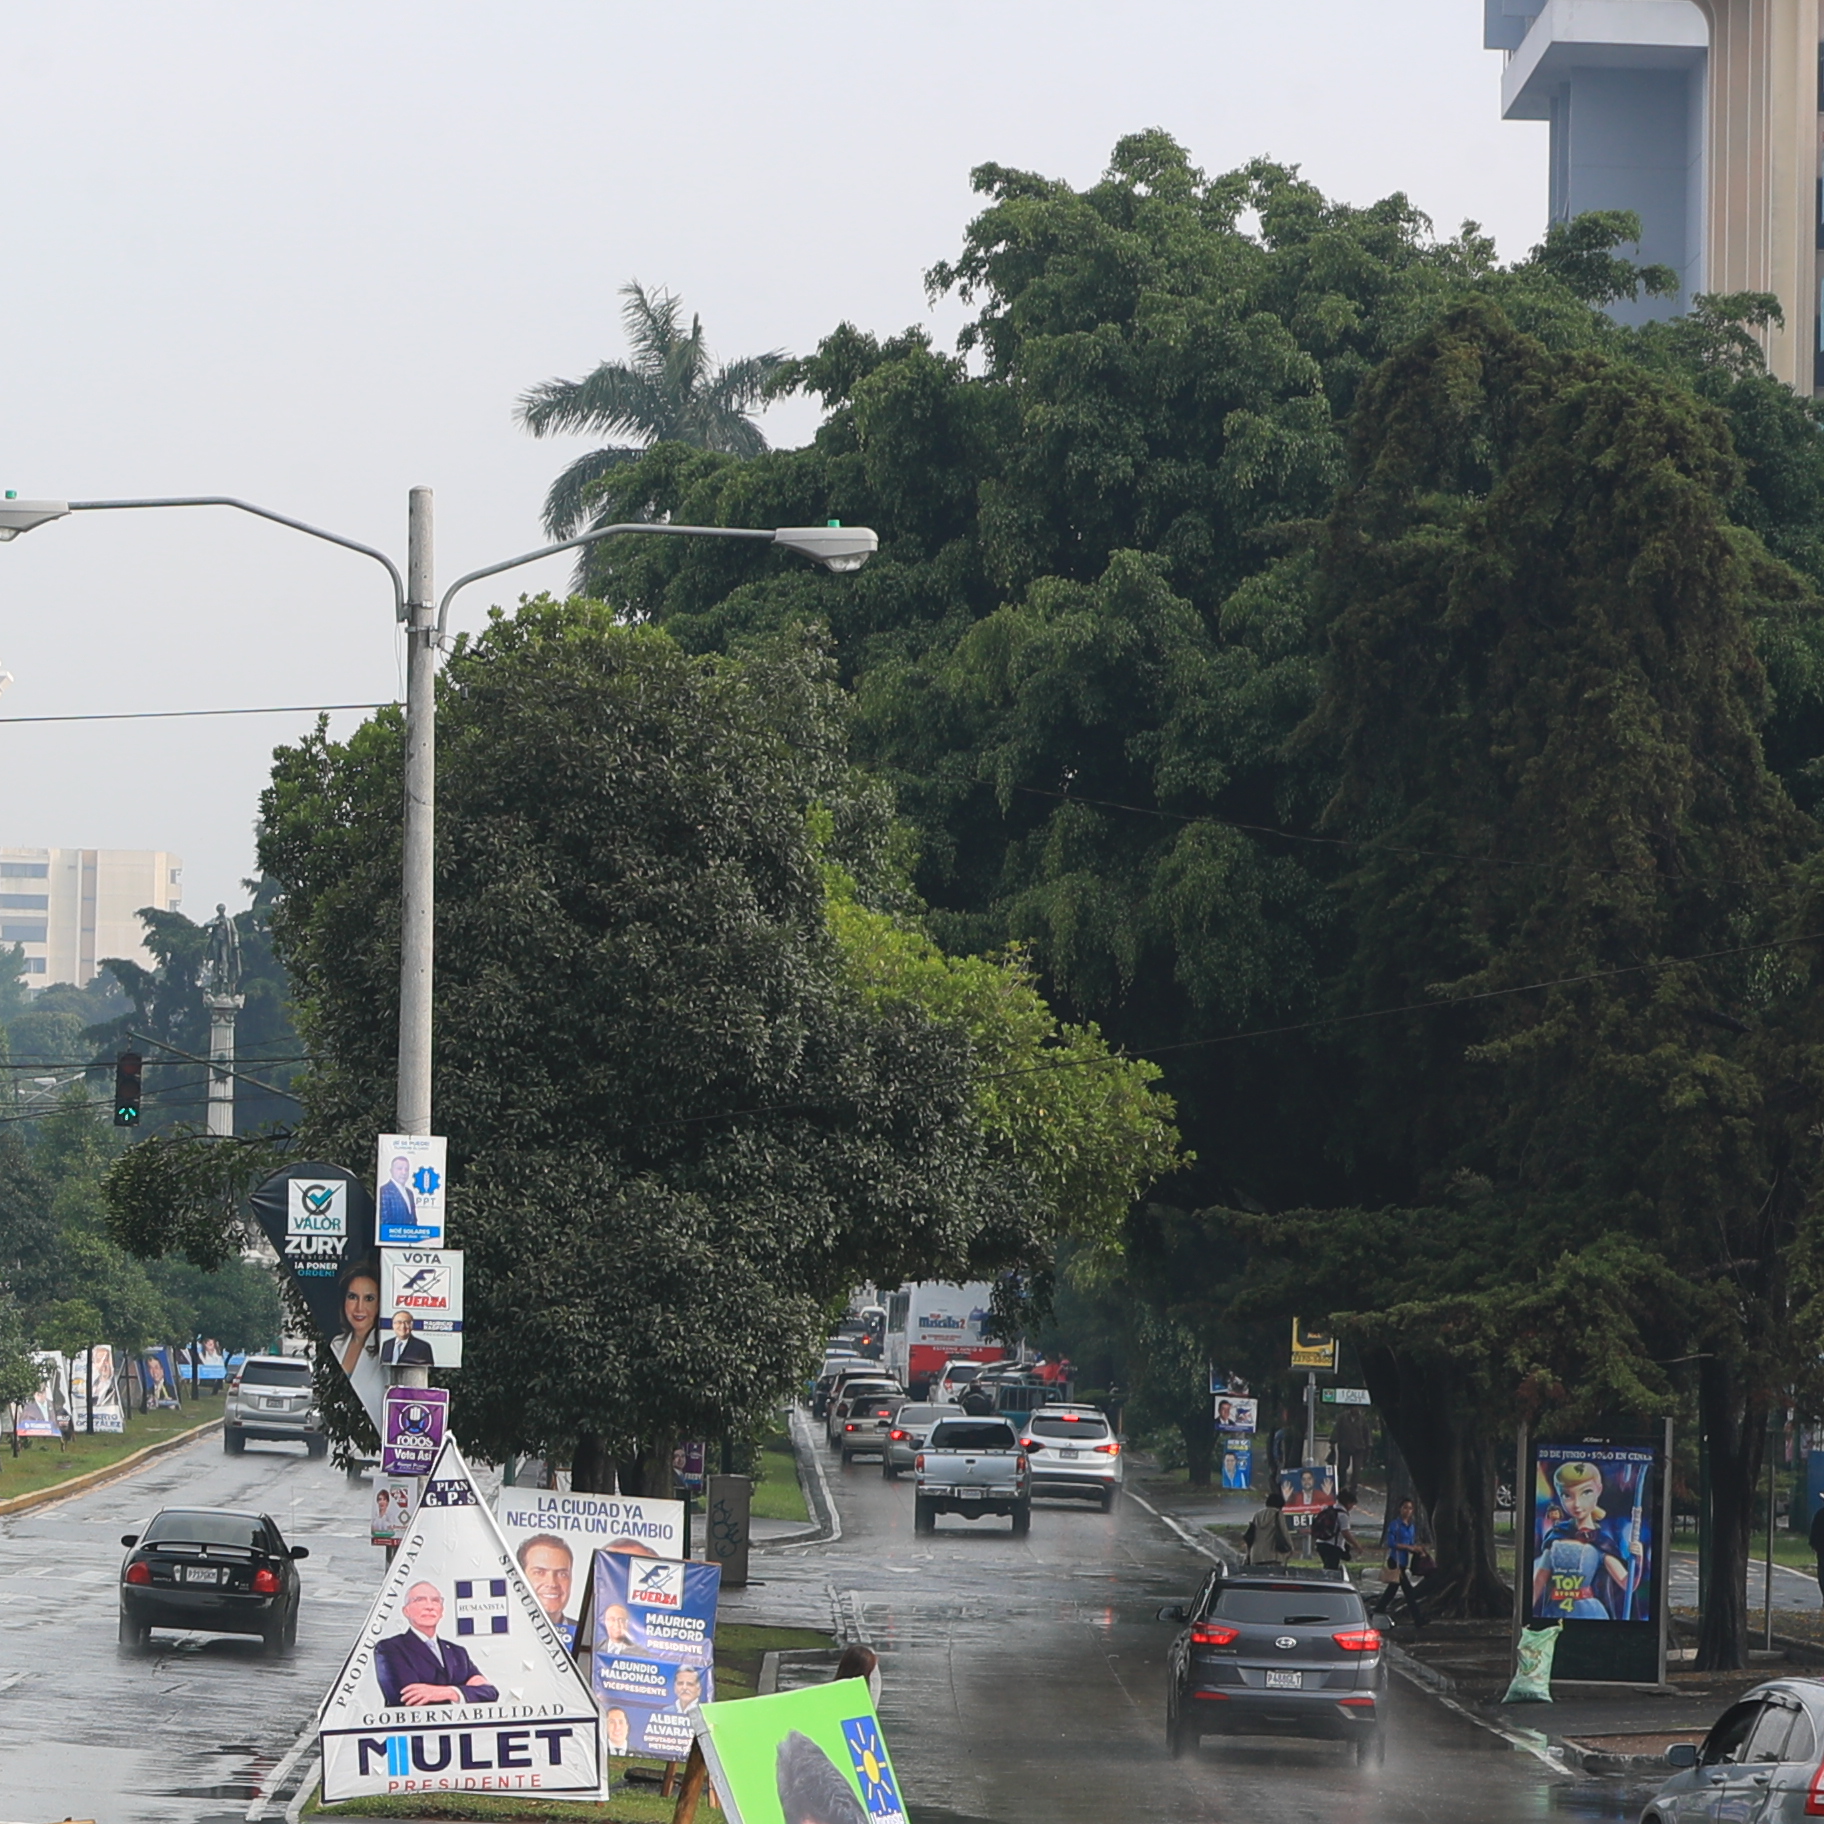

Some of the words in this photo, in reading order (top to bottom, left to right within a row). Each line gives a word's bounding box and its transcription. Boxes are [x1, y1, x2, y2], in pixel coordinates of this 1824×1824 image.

[416, 1197, 436, 1206] PPT
[293, 1216, 342, 1232] VALOR
[284, 1235, 349, 1256] ZURY
[306, 1261, 338, 1271] PONER
[403, 1252, 443, 1265] VOTA
[395, 1295, 447, 1308] FUERZA
[394, 1448, 416, 1461] Vota
[1561, 1450, 1586, 1460] JUNIO
[437, 1481, 469, 1493] PLAN
[537, 1496, 558, 1513] LA
[562, 1498, 620, 1518] CIUDAD
[624, 1504, 644, 1520] YA
[506, 1511, 583, 1531] NECESITA
[585, 1518, 607, 1534] UN
[610, 1520, 674, 1540] CAMBIO
[1552, 1574, 1585, 1591] TOY
[631, 1589, 678, 1606] FUERZA
[1559, 1598, 1575, 1613] 4
[458, 1602, 505, 1612] HUMANISTA
[498, 1553, 570, 1675] SEGURIDAD
[336, 1532, 425, 1709] PRODUCTIVIDAD
[645, 1612, 707, 1630] MAURICIO
[645, 1624, 704, 1642] RADFORD
[646, 1639, 703, 1655] PRESIDENTE
[611, 1659, 659, 1675] ABUNDIO
[600, 1668, 666, 1686] MALDONADO
[602, 1680, 667, 1697] VICEPRESIDENTE
[362, 1703, 565, 1726] GOBERNABILIDAD
[357, 1728, 574, 1777] MULET
[387, 1773, 543, 1795] PRESIDENTE
